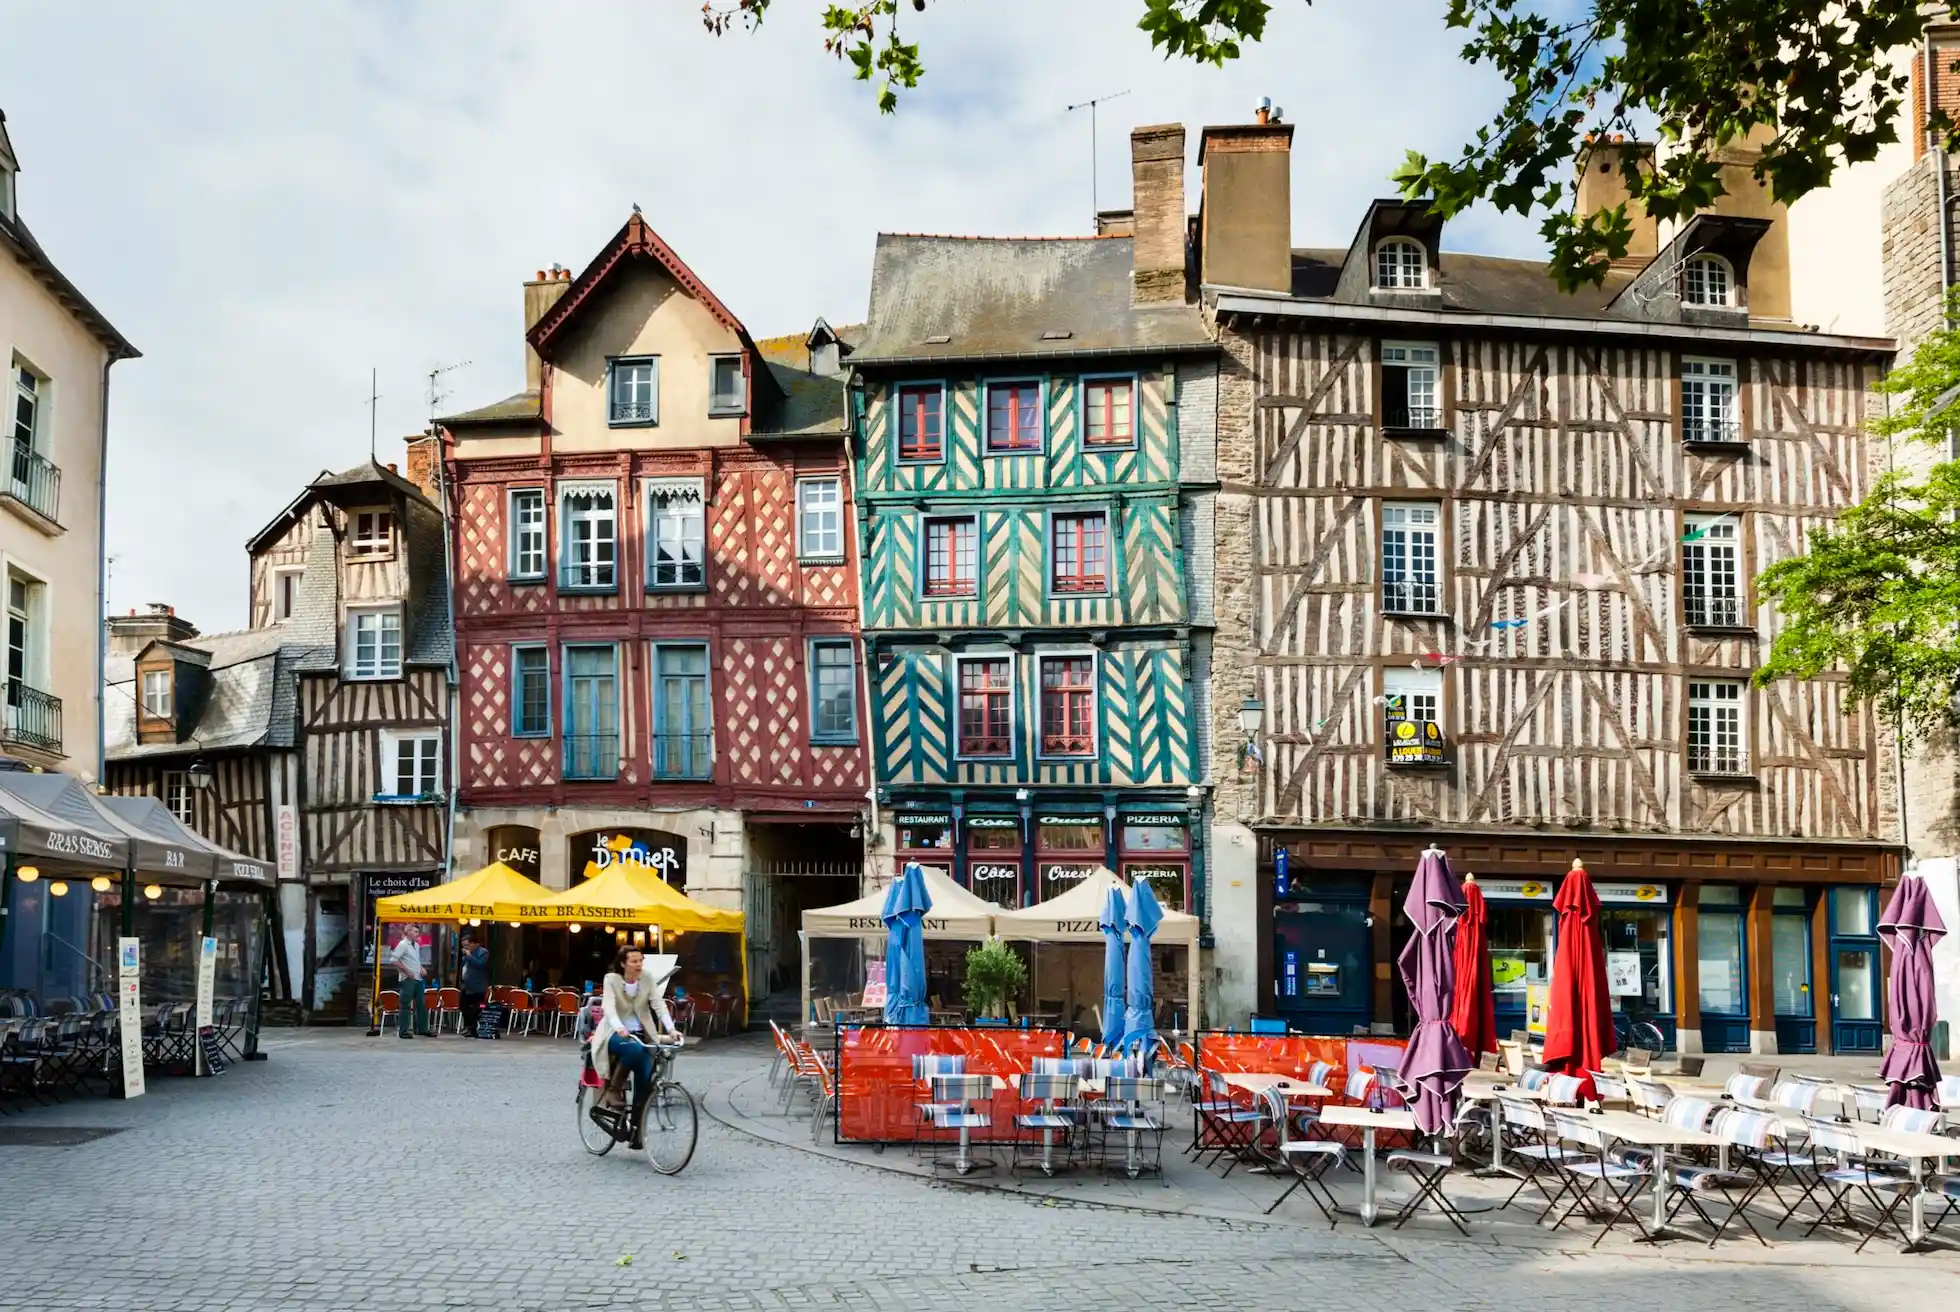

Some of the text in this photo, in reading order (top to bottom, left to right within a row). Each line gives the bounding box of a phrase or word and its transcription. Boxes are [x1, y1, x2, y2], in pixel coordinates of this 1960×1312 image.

[898, 815, 949, 824] RESTAURANT
[1126, 815, 1181, 824] PIZZERIA
[280, 811, 293, 872] AGENCE
[165, 850, 185, 868] BAR
[497, 848, 538, 864] CAFE
[974, 865, 1016, 880] Côte
[1048, 865, 1094, 881] Ouest
[1131, 870, 1178, 878] PIZZERIA
[369, 876, 430, 887] Le choix d'Isa
[399, 903, 440, 913] SALLE
[443, 904, 453, 914] A
[519, 906, 636, 918] BAR BRASSERIE
[849, 918, 949, 930] RESTANT
